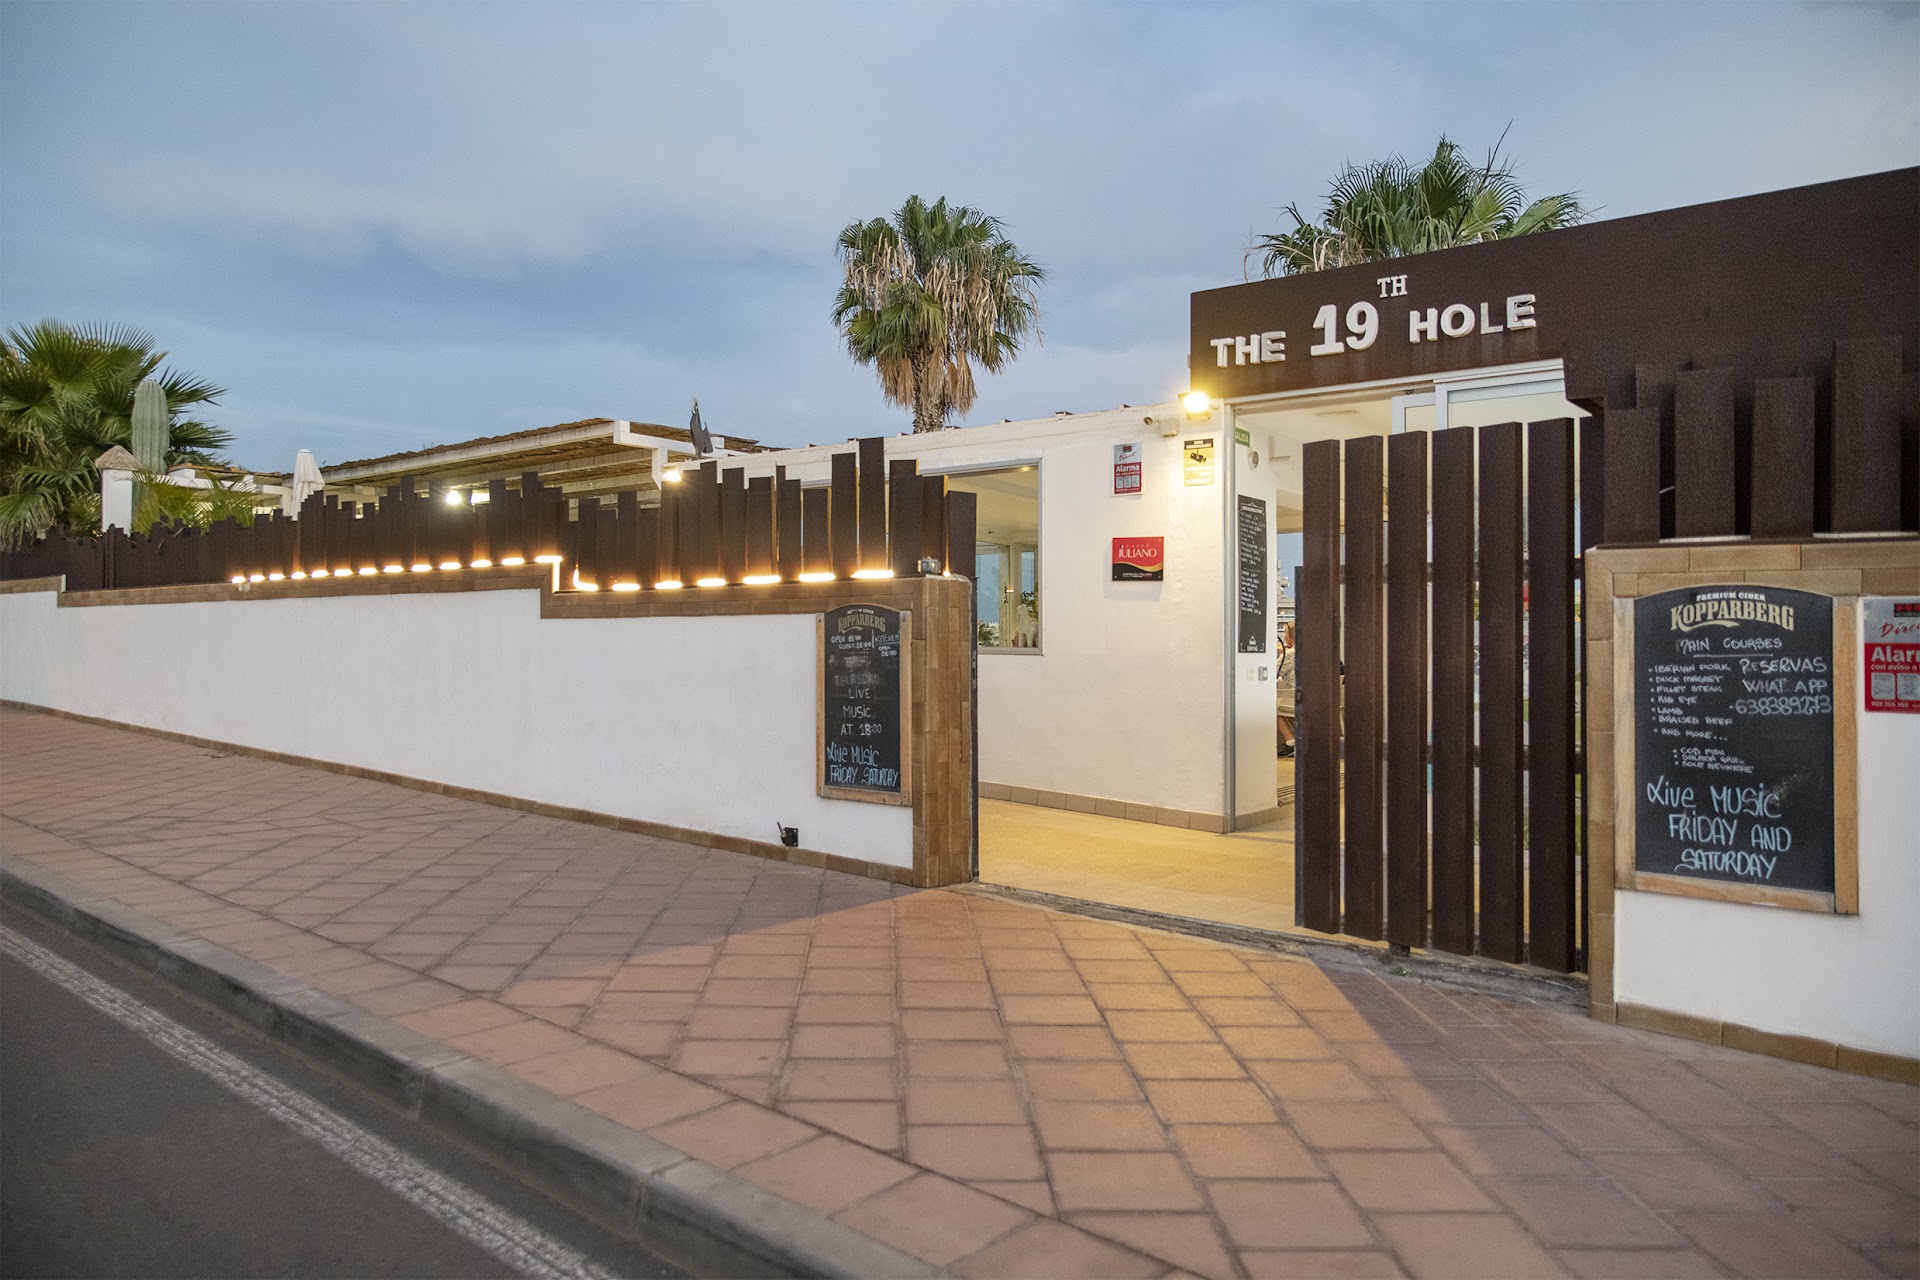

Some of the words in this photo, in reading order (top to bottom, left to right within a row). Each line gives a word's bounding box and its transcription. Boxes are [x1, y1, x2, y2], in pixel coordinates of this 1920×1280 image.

[1210, 331, 1286, 368] THE
[1310, 301, 1379, 356] 19
[1377, 274, 1408, 298] TH
[1409, 294, 1536, 343] HOLE
[1115, 464, 1140, 473] Alarma
[1118, 545, 1157, 558] IULIANO
[1696, 591, 1737, 601] PREMIUM
[1738, 591, 1766, 601] CIDER
[1671, 599, 1795, 632] KOPPARBERG
[838, 613, 886, 634] KOPPARBERG
[831, 635, 846, 643] OPEN
[874, 634, 900, 643] KITCHEN
[1723, 637, 1782, 650] COURSES
[1655, 663, 1695, 675] IBERIAN
[1699, 663, 1731, 671] PORK
[1739, 657, 1828, 675] RESERVAS
[1887, 663, 1910, 671] aviso
[1656, 685, 1686, 693] FILLET
[1742, 678, 1787, 693] WHAT
[848, 687, 871, 699] LIVE
[1658, 695, 1674, 704] RIB
[1678, 695, 1697, 705] EYE
[842, 704, 871, 719] MUSIC
[1657, 706, 1683, 715] LAMB
[1658, 715, 1699, 725] BRAISED
[1704, 716, 1733, 725] BEEF
[841, 723, 854, 735] AT
[1661, 727, 1680, 736] AND
[827, 741, 848, 762] Live
[851, 745, 880, 767] MUSIC
[1680, 747, 1701, 755] COD
[1681, 754, 1716, 762] SALMON
[1681, 760, 1704, 768] SOLE
[830, 764, 859, 784] FRIDAY
[862, 766, 899, 787] SATURDAY
[1647, 775, 1697, 809] Live
[1710, 782, 1782, 819] MUSIC
[1668, 810, 1737, 846] FRIDAY
[1751, 824, 1792, 852] AND
[1674, 848, 1777, 880] SATURDAY
